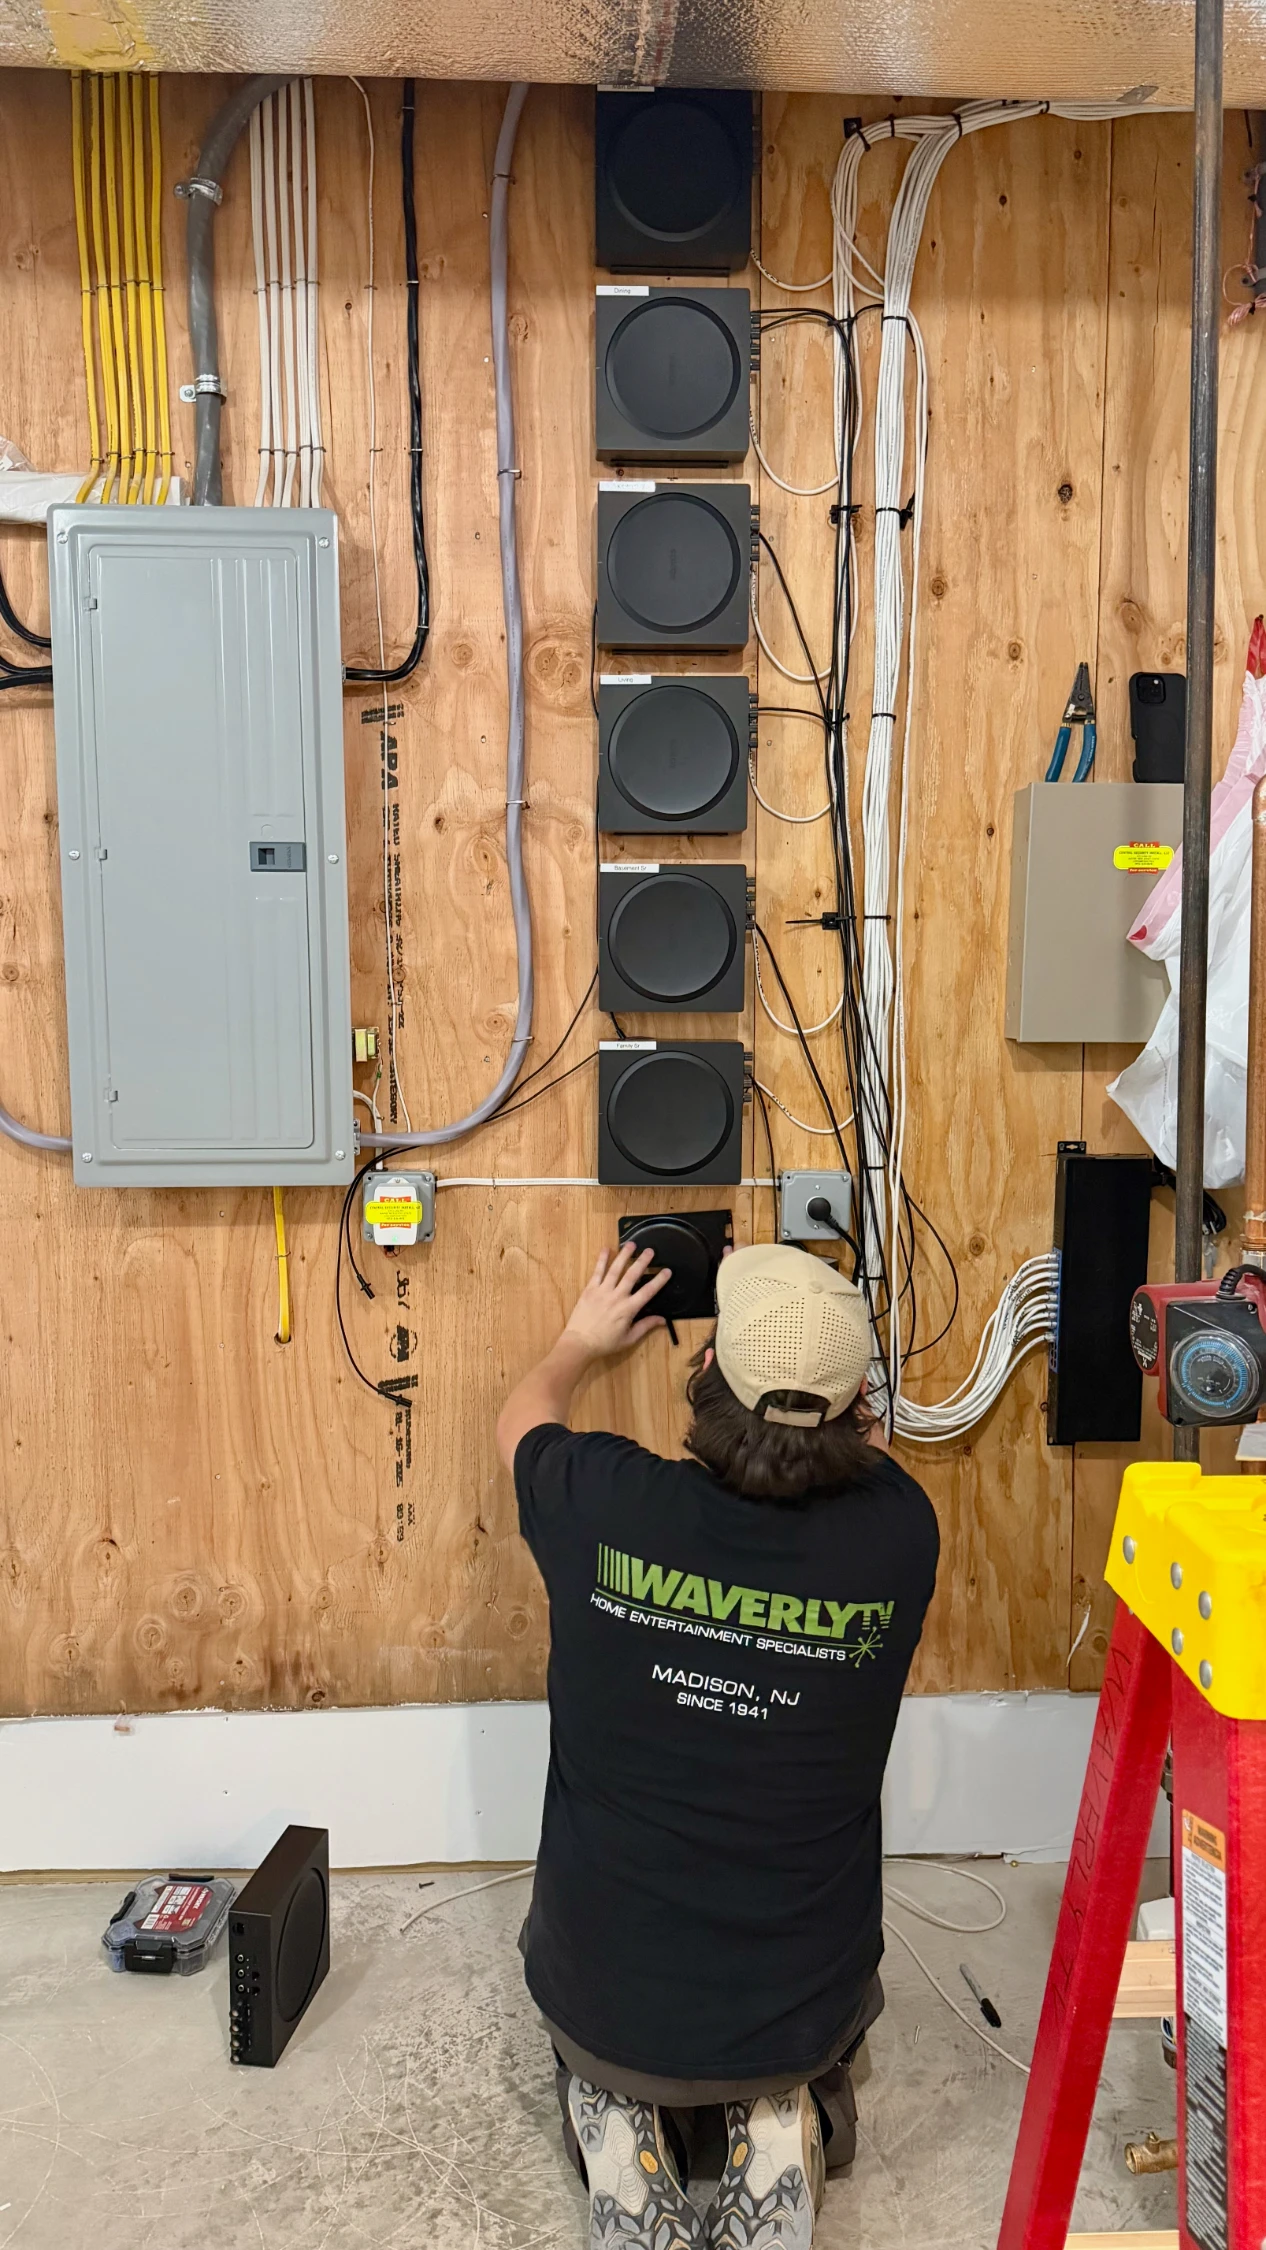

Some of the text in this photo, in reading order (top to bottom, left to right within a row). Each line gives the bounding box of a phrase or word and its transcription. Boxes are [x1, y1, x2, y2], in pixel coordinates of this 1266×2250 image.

[590, 1592, 847, 1661] HOME ENTERTAINMENT SPECIALISTS
[630, 1556, 855, 1639] WAVERLY
[651, 1664, 801, 1707] MADISON, NJ
[676, 1692, 769, 1720] SINCE 1941
[1064, 1647, 1132, 1941] WAVERLY
